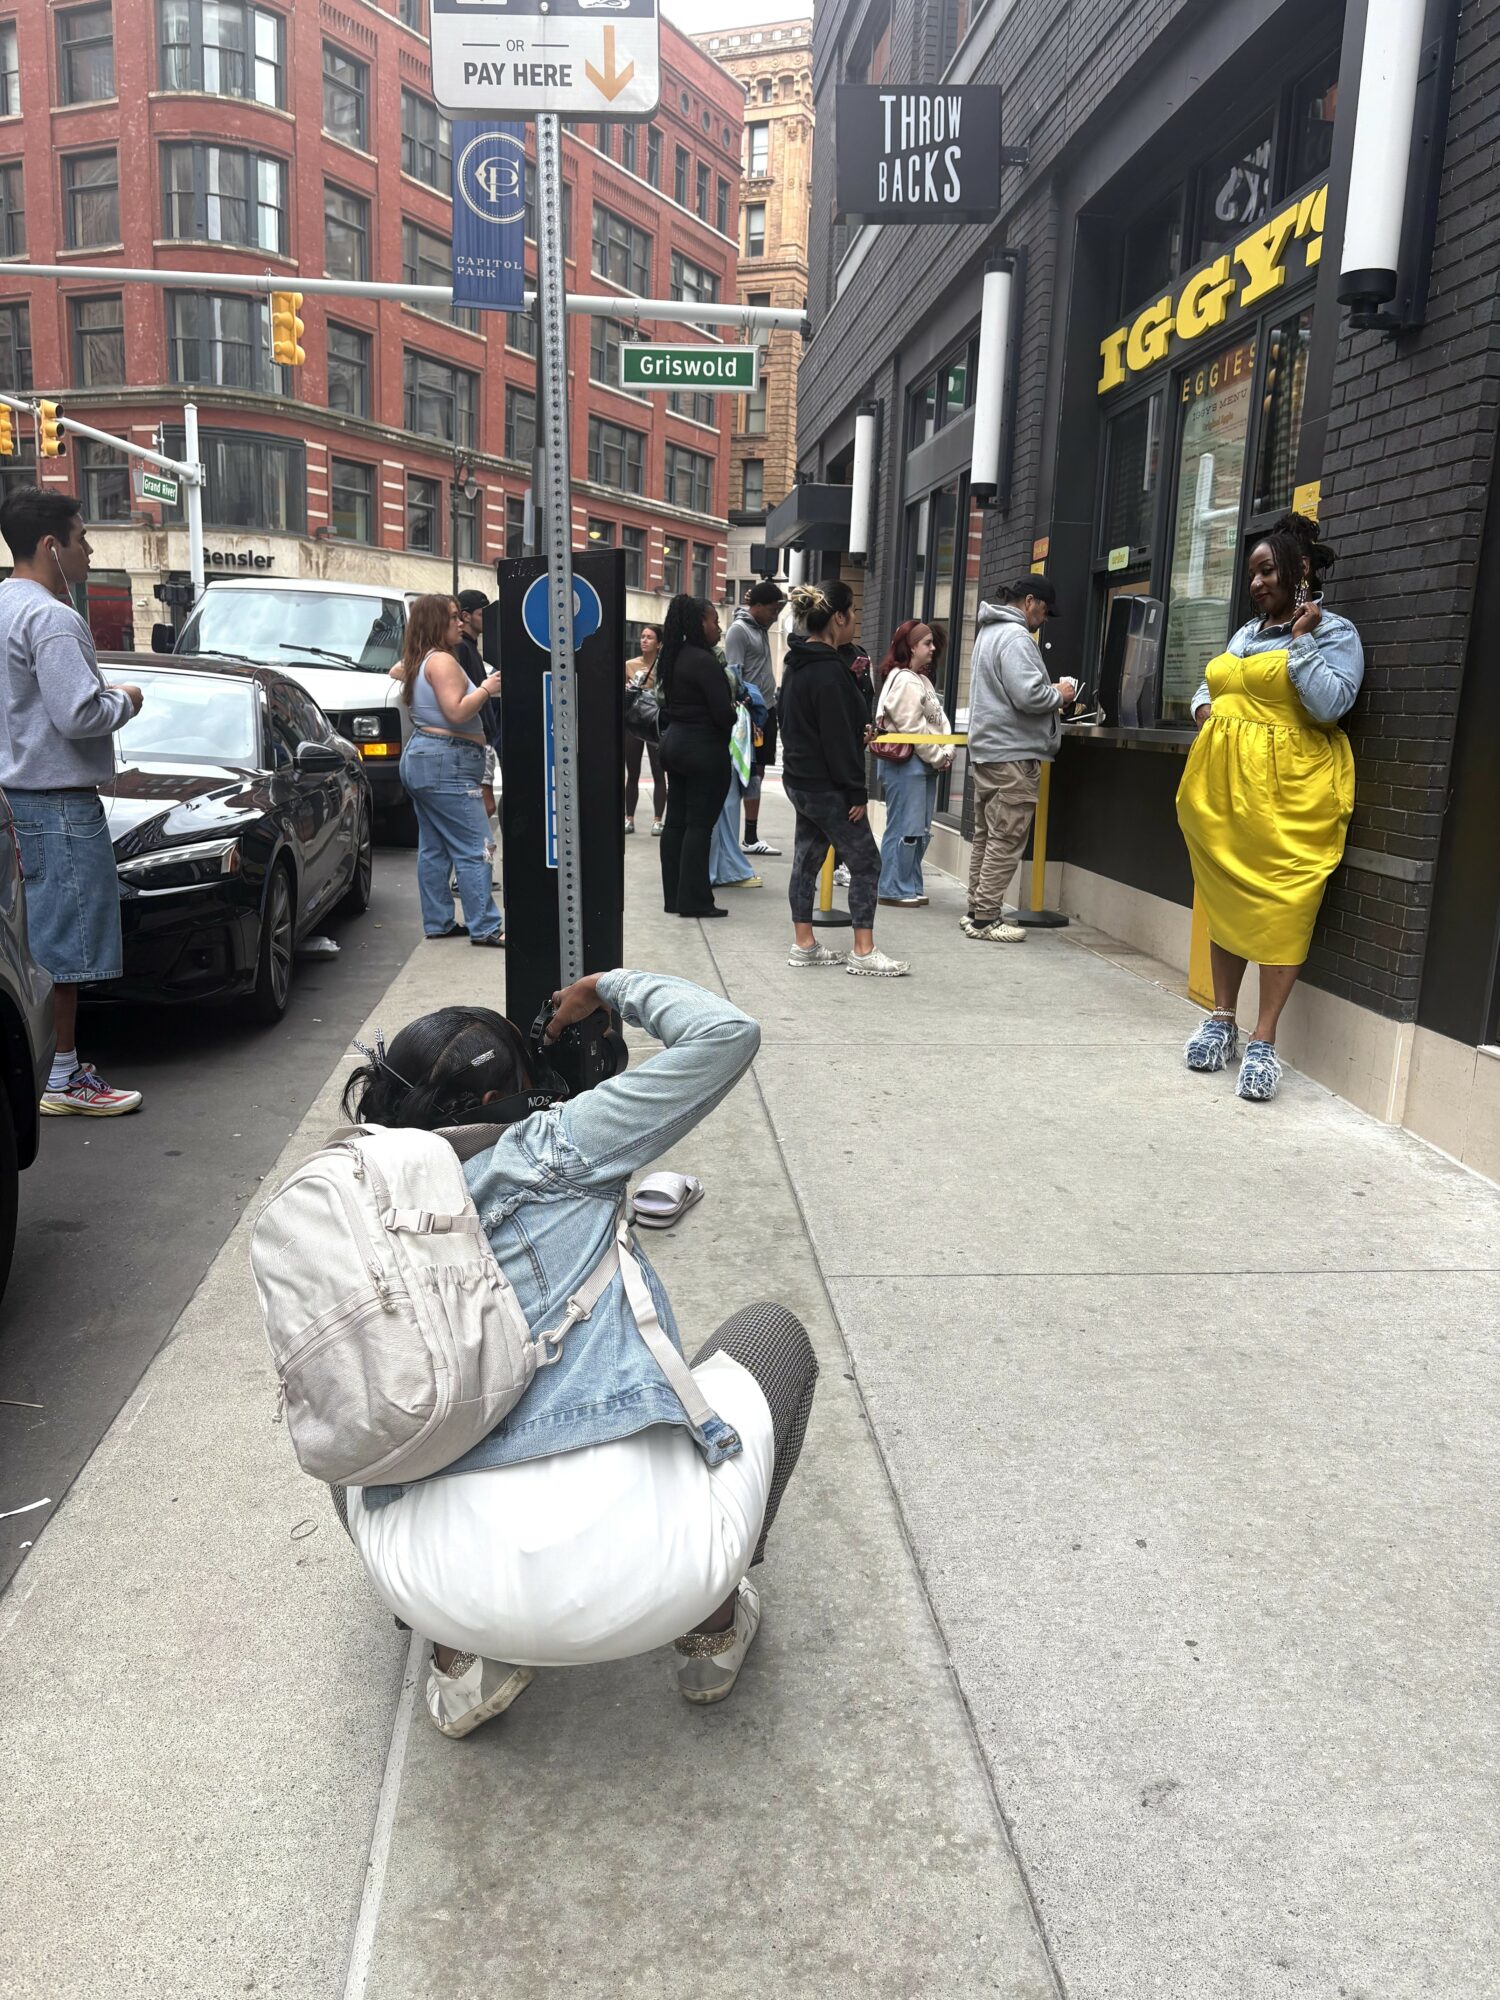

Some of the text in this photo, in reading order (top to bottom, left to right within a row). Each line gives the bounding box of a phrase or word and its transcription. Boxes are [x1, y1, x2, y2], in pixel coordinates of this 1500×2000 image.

[506, 39, 525, 52] OR
[463, 62, 573, 87] PAY HERE
[878, 94, 962, 154] THROW
[878, 145, 962, 203] BACKS
[456, 255, 522, 270] CAPITOL
[456, 266, 497, 278] PARK
[639, 354, 737, 378] Griswold
[144, 478, 177, 498] Grand River
